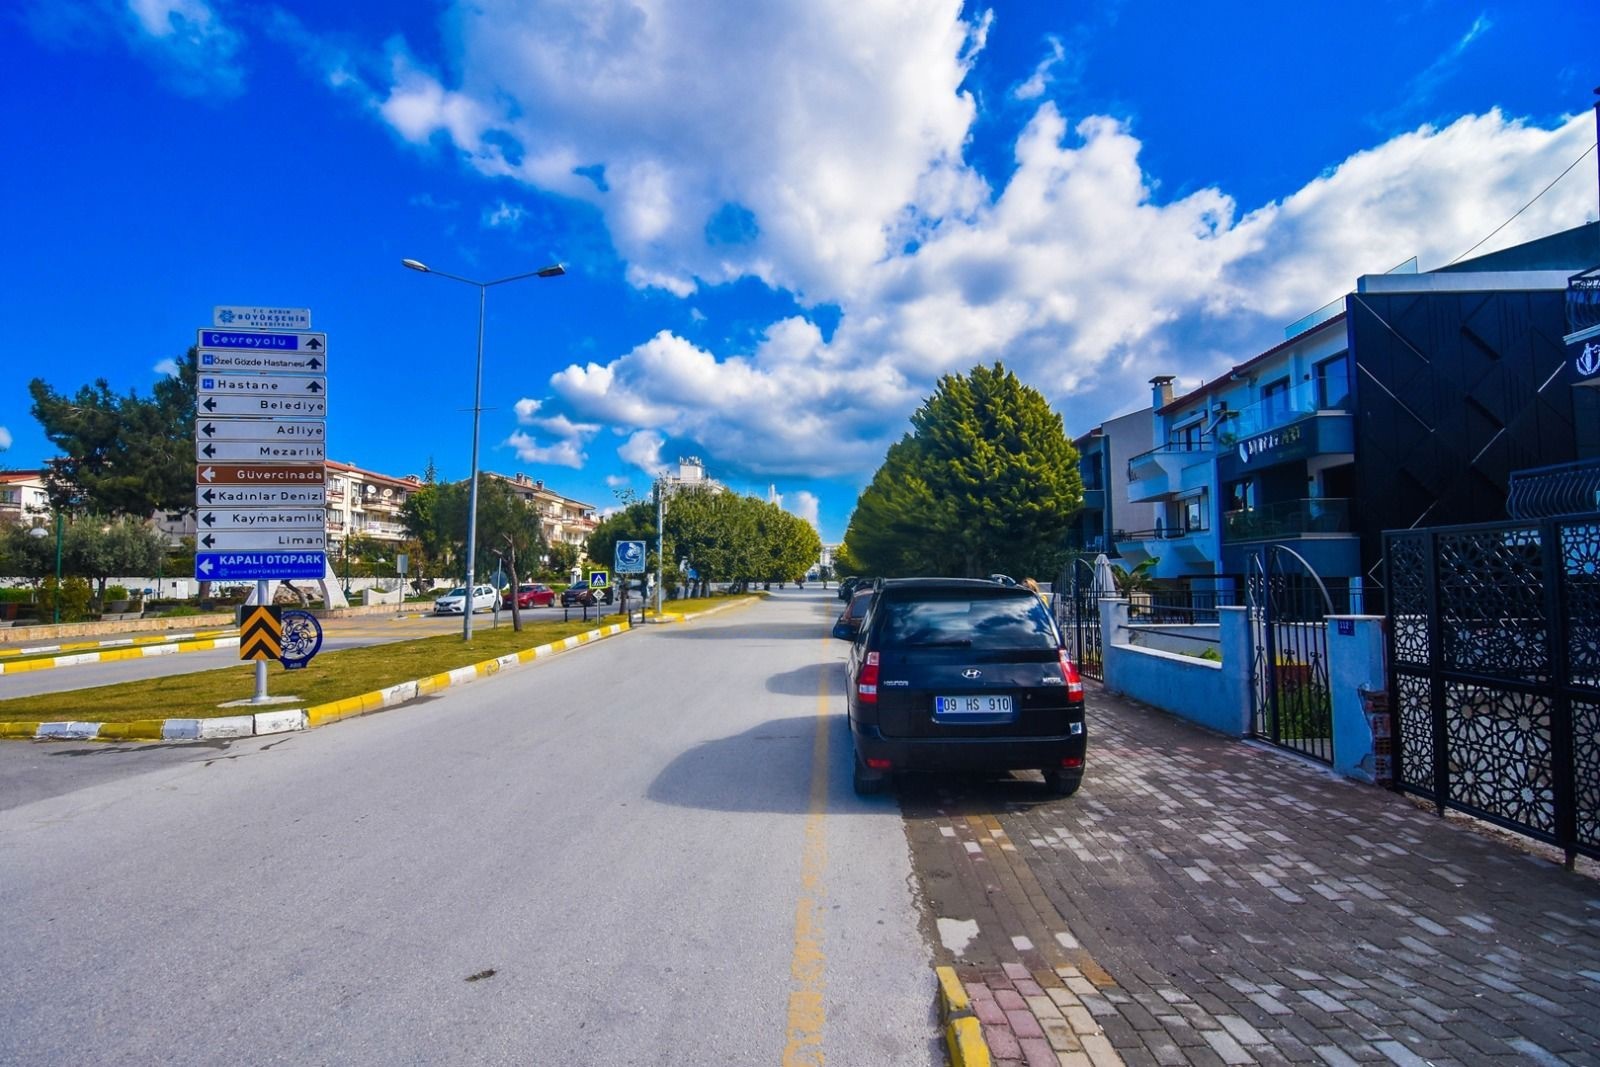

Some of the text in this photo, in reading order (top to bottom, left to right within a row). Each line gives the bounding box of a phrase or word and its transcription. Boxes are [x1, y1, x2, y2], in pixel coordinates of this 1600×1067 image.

[238, 313, 306, 322] BÜYÜKŞEHİR
[211, 334, 287, 347] Çevreyolu
[214, 356, 233, 365] Özel
[234, 357, 262, 366] Gözde
[264, 359, 305, 367] Hastanesi
[218, 380, 279, 390] Hastane
[260, 400, 324, 412] Belediye
[277, 425, 323, 437] Adliye
[260, 447, 323, 456] Mezarlık
[237, 470, 322, 480] Güvercinada
[218, 491, 323, 501] Kadınlar Denizi
[232, 513, 323, 525] Kaymakamlık
[278, 536, 323, 545] Liman
[219, 554, 321, 565] KAPALI OTOPARK
[943, 698, 1009, 711] 09 HS 910
